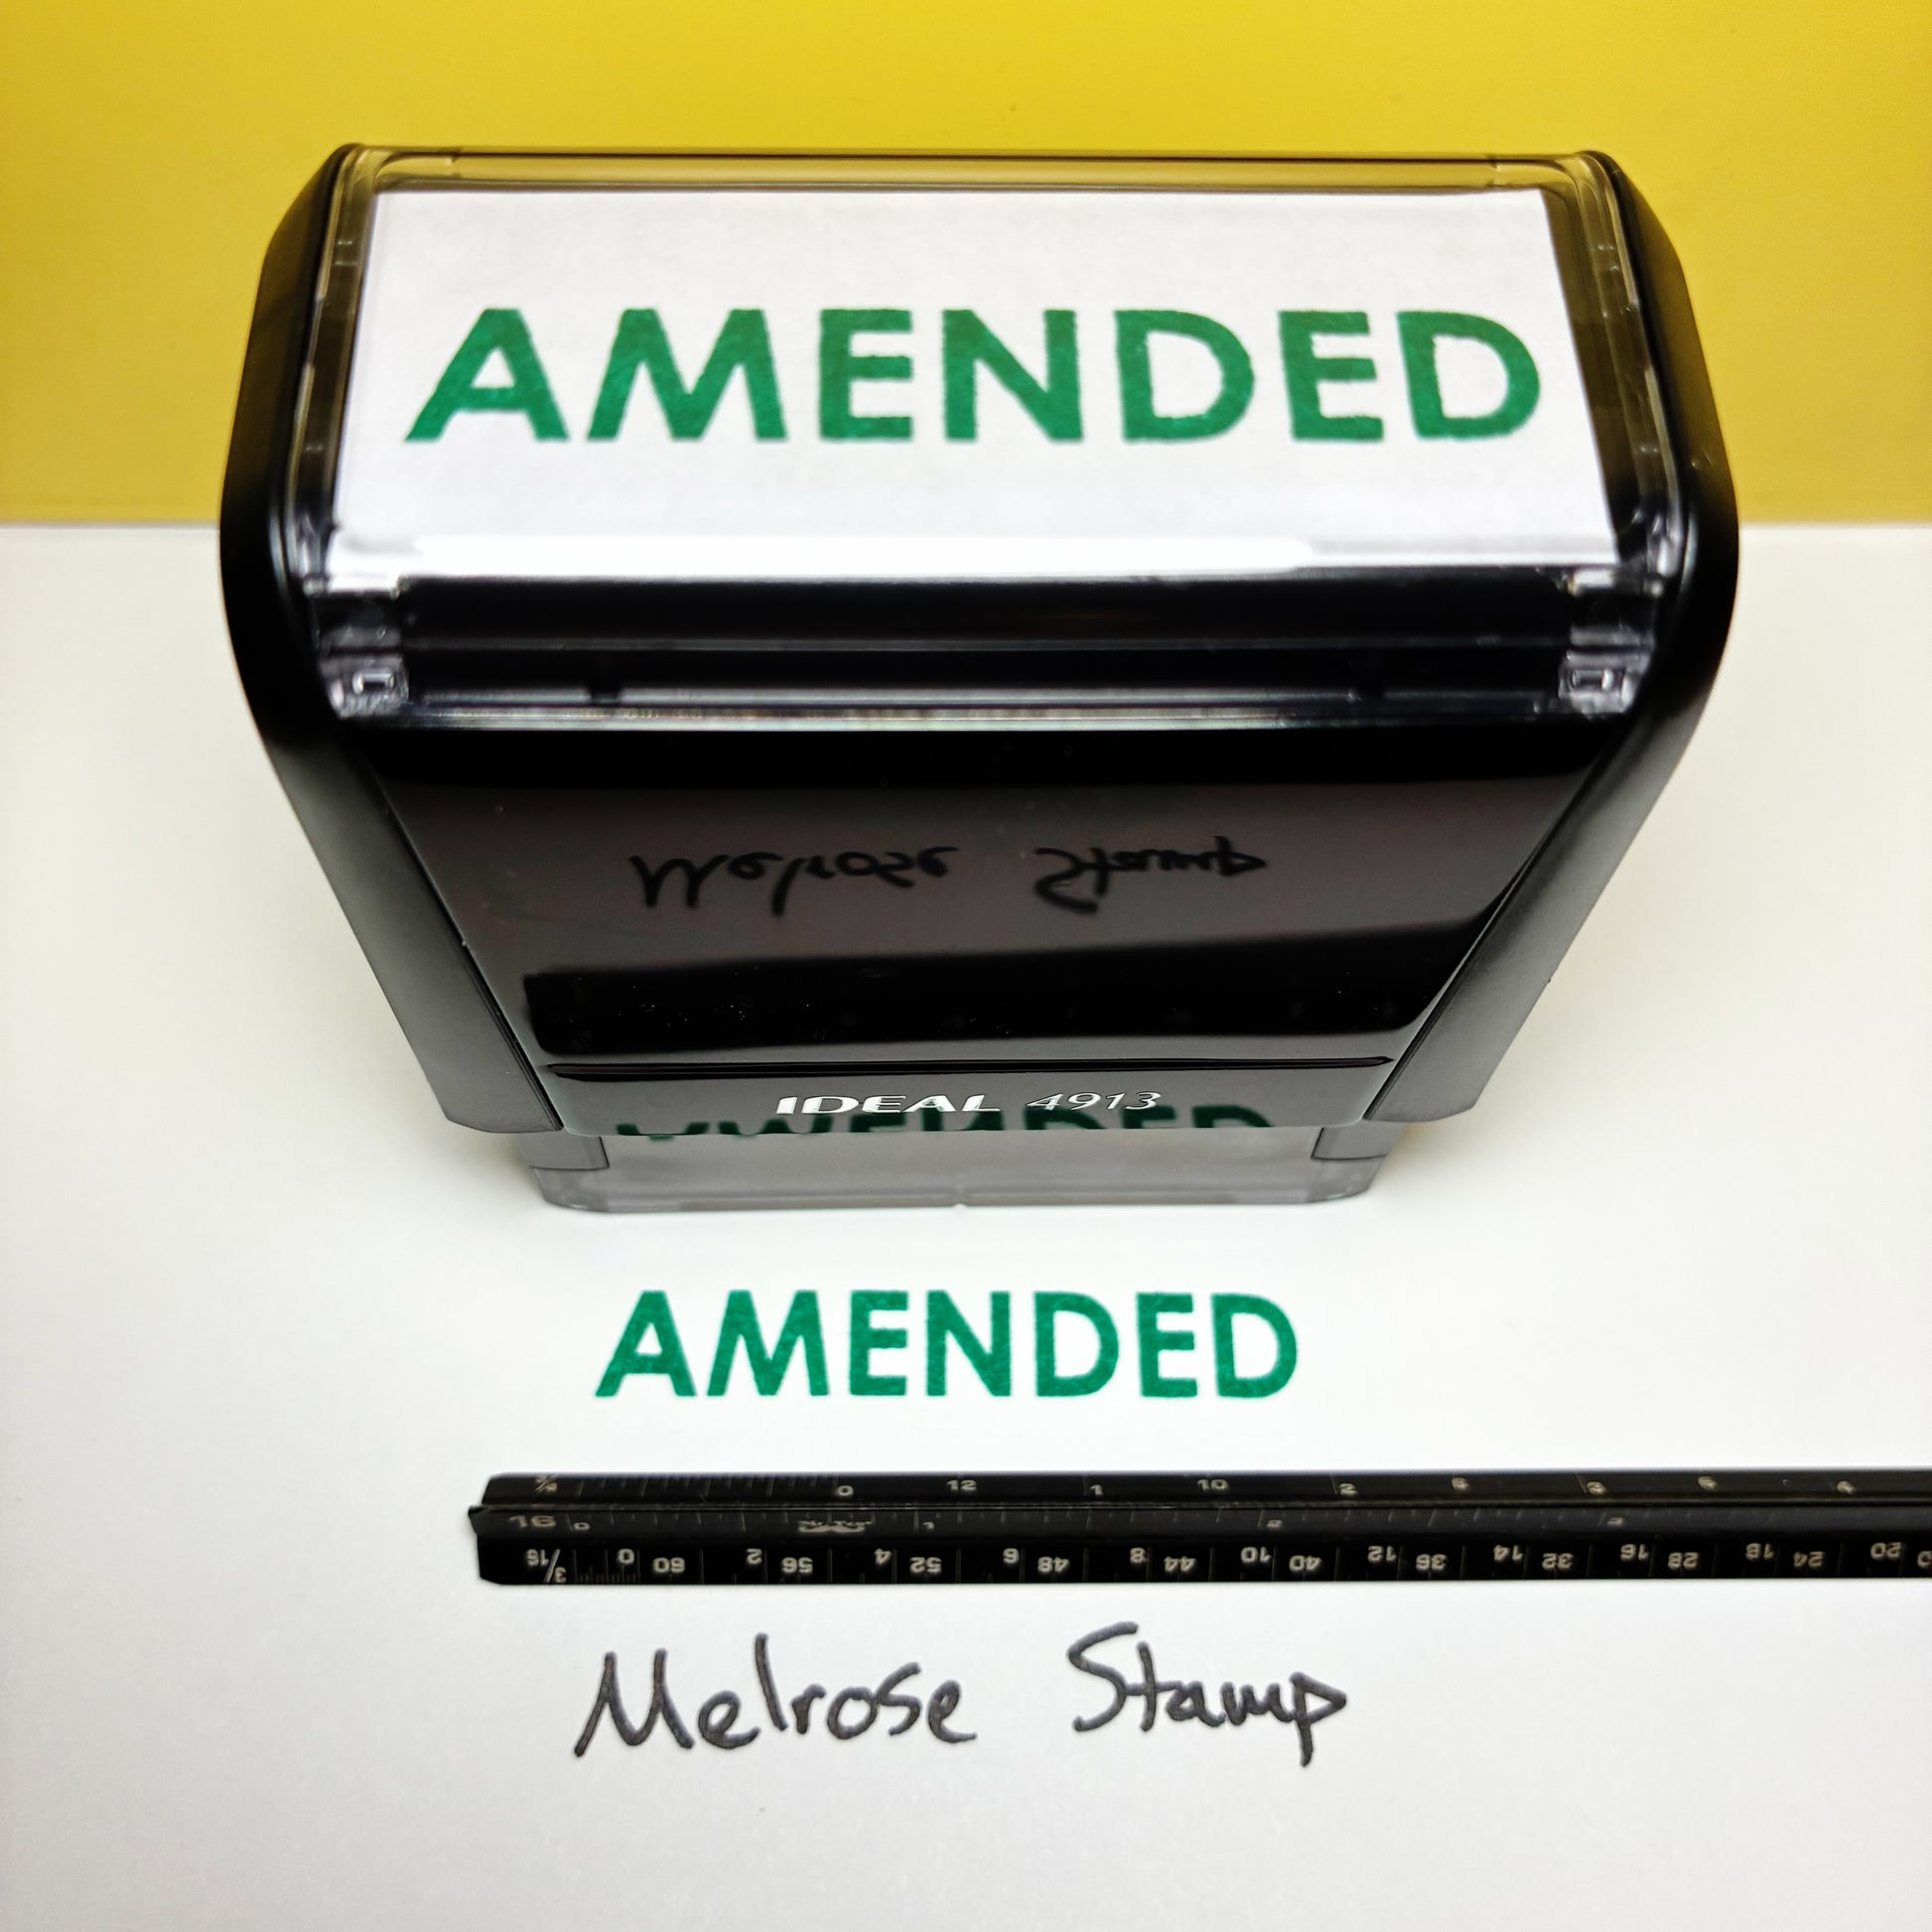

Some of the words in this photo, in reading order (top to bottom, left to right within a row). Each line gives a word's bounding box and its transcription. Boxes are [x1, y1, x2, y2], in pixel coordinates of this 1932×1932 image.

[405, 307, 1542, 444] AMENDED
[775, 1094, 1001, 1116] IDEAL
[1025, 1091, 1163, 1111] 4913
[595, 1289, 1300, 1400] AMENDED
[836, 1485, 854, 1497] 0
[946, 1479, 977, 1491] 12
[1090, 1484, 1103, 1496] 1
[1196, 1478, 1229, 1491] 10
[1339, 1482, 1358, 1496] 2
[508, 1514, 557, 1528] 16
[618, 1548, 635, 1565] 0
[747, 1548, 763, 1565] 2
[874, 1548, 892, 1566] 4
[1003, 1548, 1021, 1565] 6
[1129, 1547, 1147, 1564] 8
[1240, 1546, 1273, 1564] 10
[1367, 1545, 1398, 1562] 12
[1492, 1545, 1524, 1562] 14
[1620, 1544, 1650, 1561] 16
[1745, 1543, 1775, 1560] 18
[1870, 1542, 1902, 1560] 20
[652, 1557, 686, 1574] 60
[781, 1557, 814, 1574] 56
[909, 1557, 942, 1574] 52
[1037, 1556, 1070, 1574] 48
[1164, 1556, 1196, 1573] 44
[1289, 1555, 1322, 1572] 40
[1416, 1554, 1448, 1571] 36
[1542, 1553, 1575, 1571] 32
[1667, 1552, 1700, 1570] 28
[1793, 1551, 1825, 1569] 24
[572, 1632, 978, 1758] Melrose
[1065, 1621, 1347, 1768] Stamp
